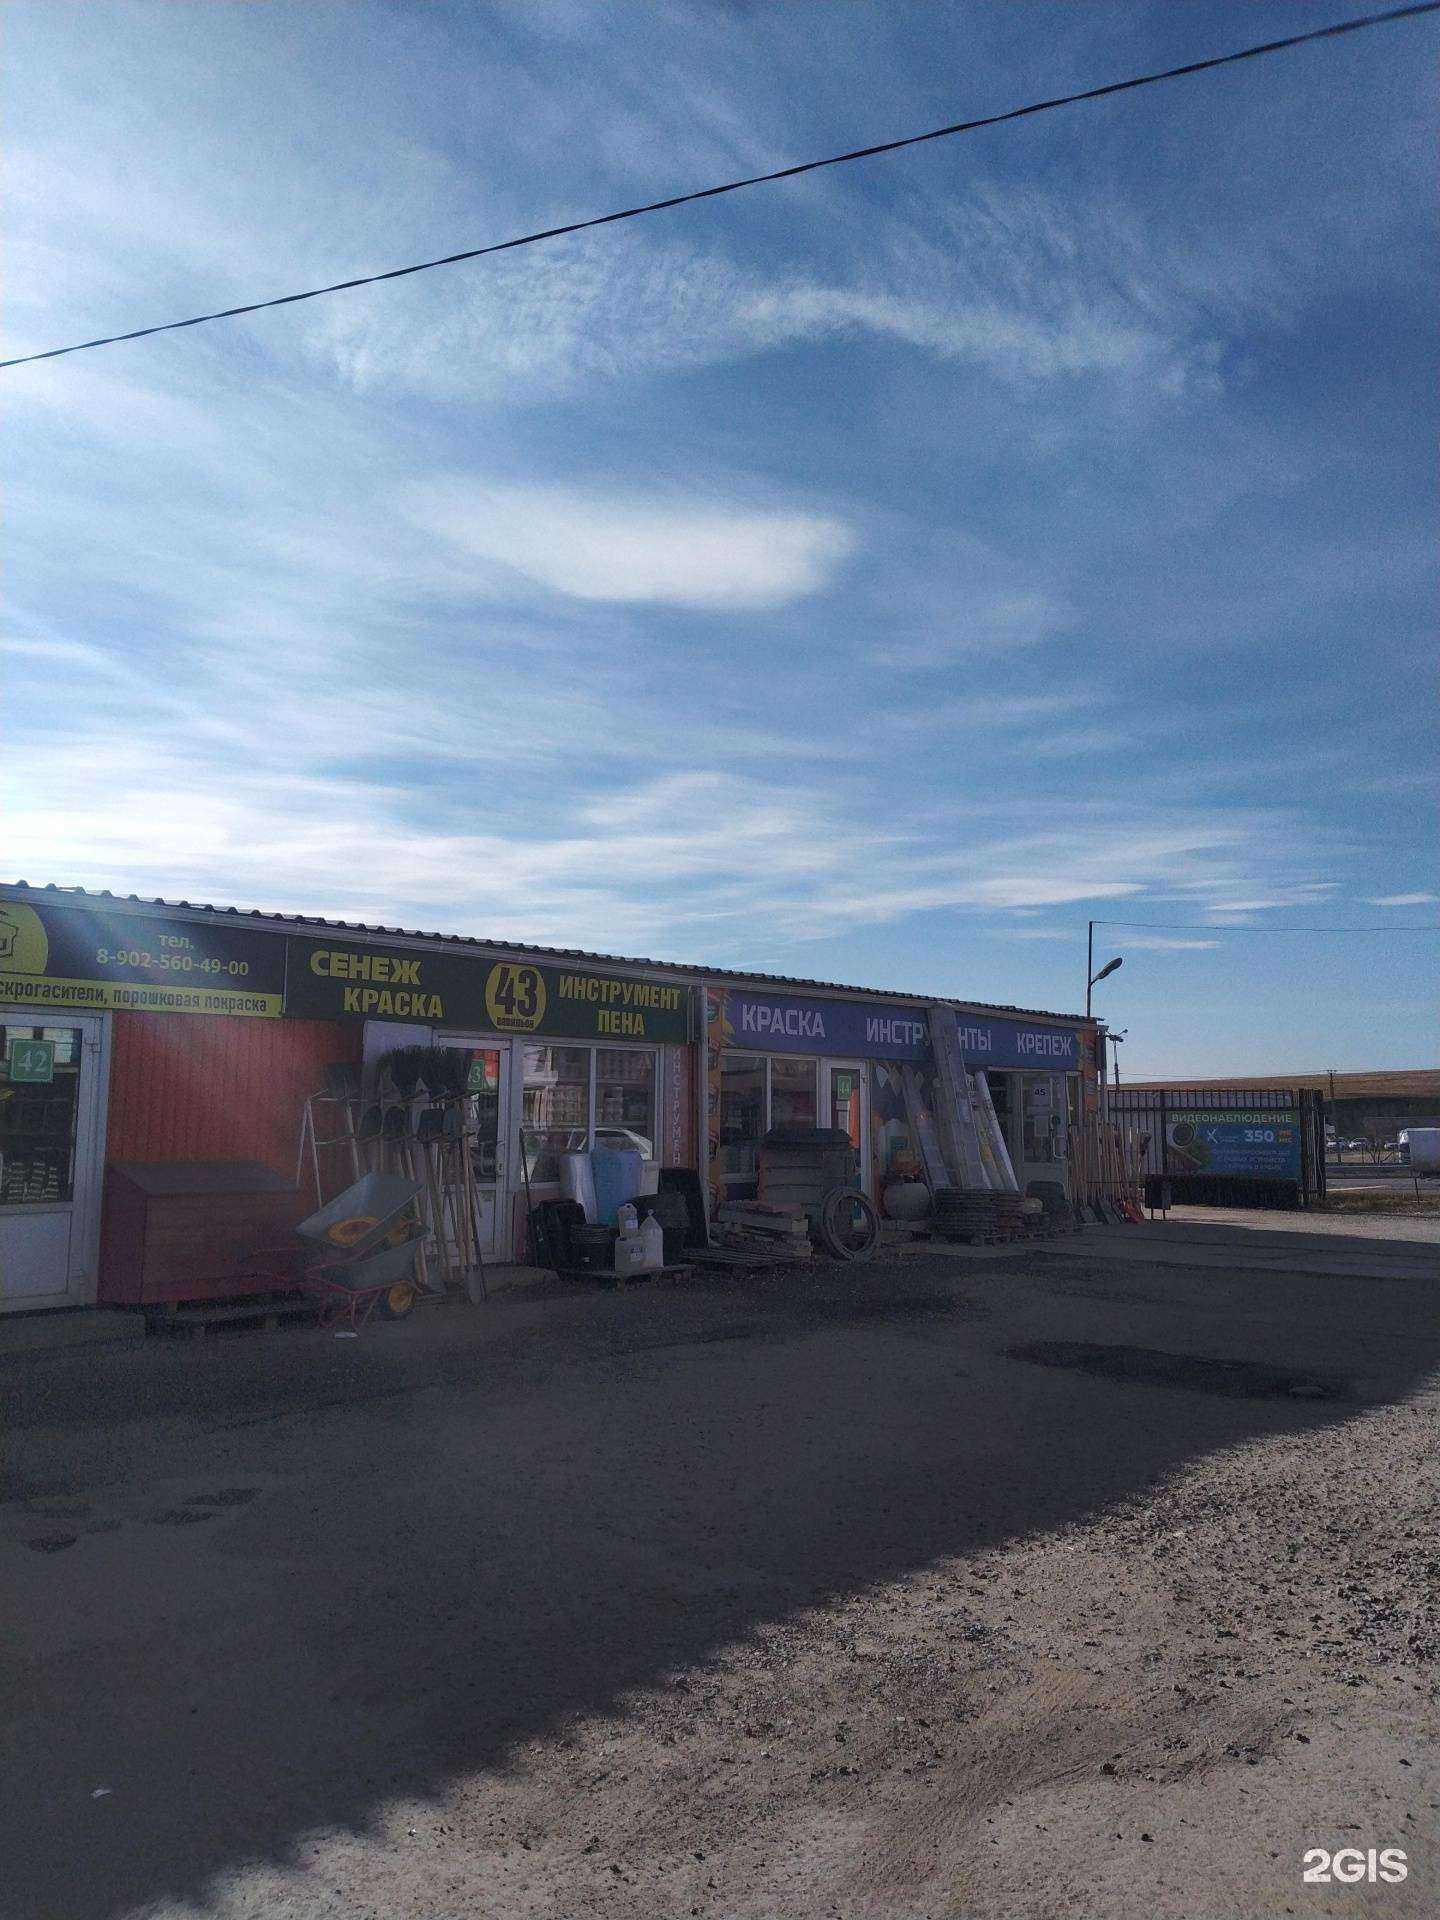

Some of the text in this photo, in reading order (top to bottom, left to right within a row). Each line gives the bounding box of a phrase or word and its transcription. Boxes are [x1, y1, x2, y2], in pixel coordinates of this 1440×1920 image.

[96, 948, 249, 976] 8-902-560-49-00
[309, 950, 422, 986] СЕНЕЖ
[113, 988, 200, 1008] порошковая
[204, 996, 267, 1013] покраска
[343, 987, 444, 1018] КРАСКА
[495, 967, 538, 1017] 43
[558, 975, 681, 1010] ИНСТРУМЕНТ
[597, 1009, 645, 1035] ПЕНА
[741, 1004, 1073, 1056] КРАСКА ИНСТРНТЫ КРЕПЕЖ
[16, 1050, 48, 1072] 42
[1171, 1113, 1293, 1123] ВИДЕОНАБЛЮДЕНИЕ
[1243, 1129, 1275, 1143] 350
